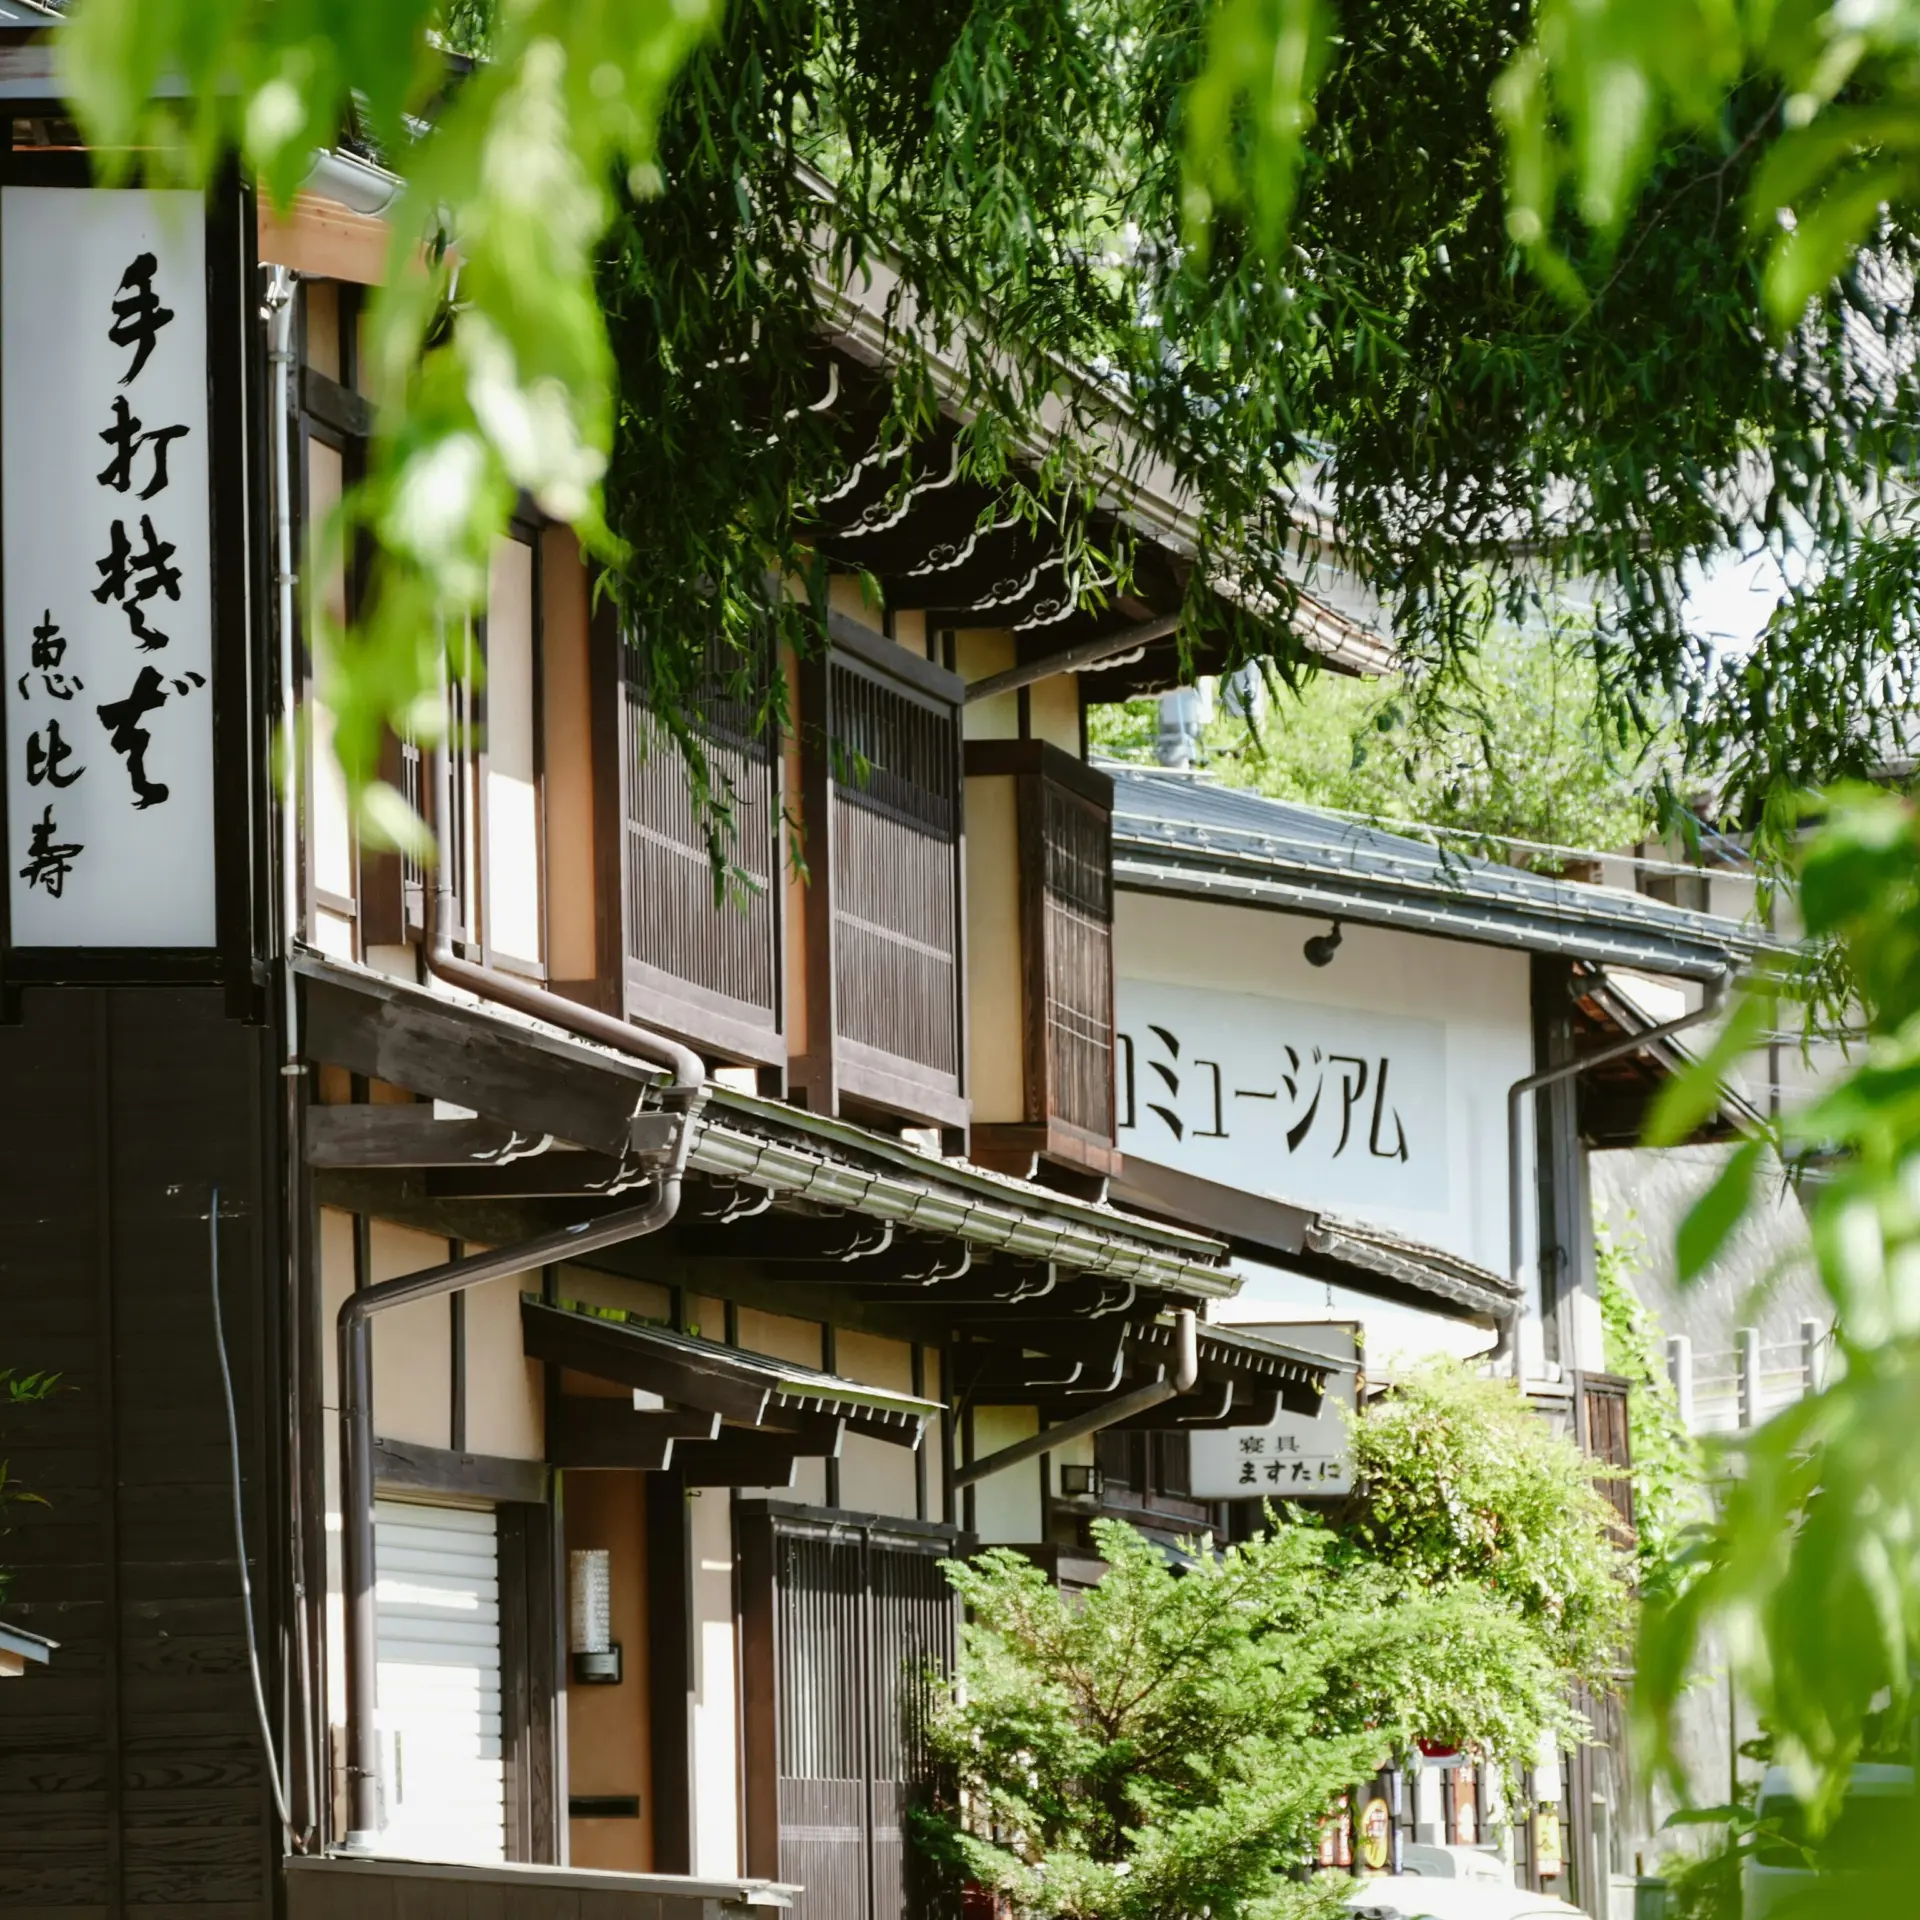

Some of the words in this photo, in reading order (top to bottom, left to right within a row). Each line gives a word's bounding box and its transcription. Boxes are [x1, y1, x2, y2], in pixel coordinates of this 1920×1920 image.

[17, 609, 87, 899] 恵比寿
[1239, 1436, 1300, 1454] 寝具
[1238, 1460, 1342, 1485] ますたに
